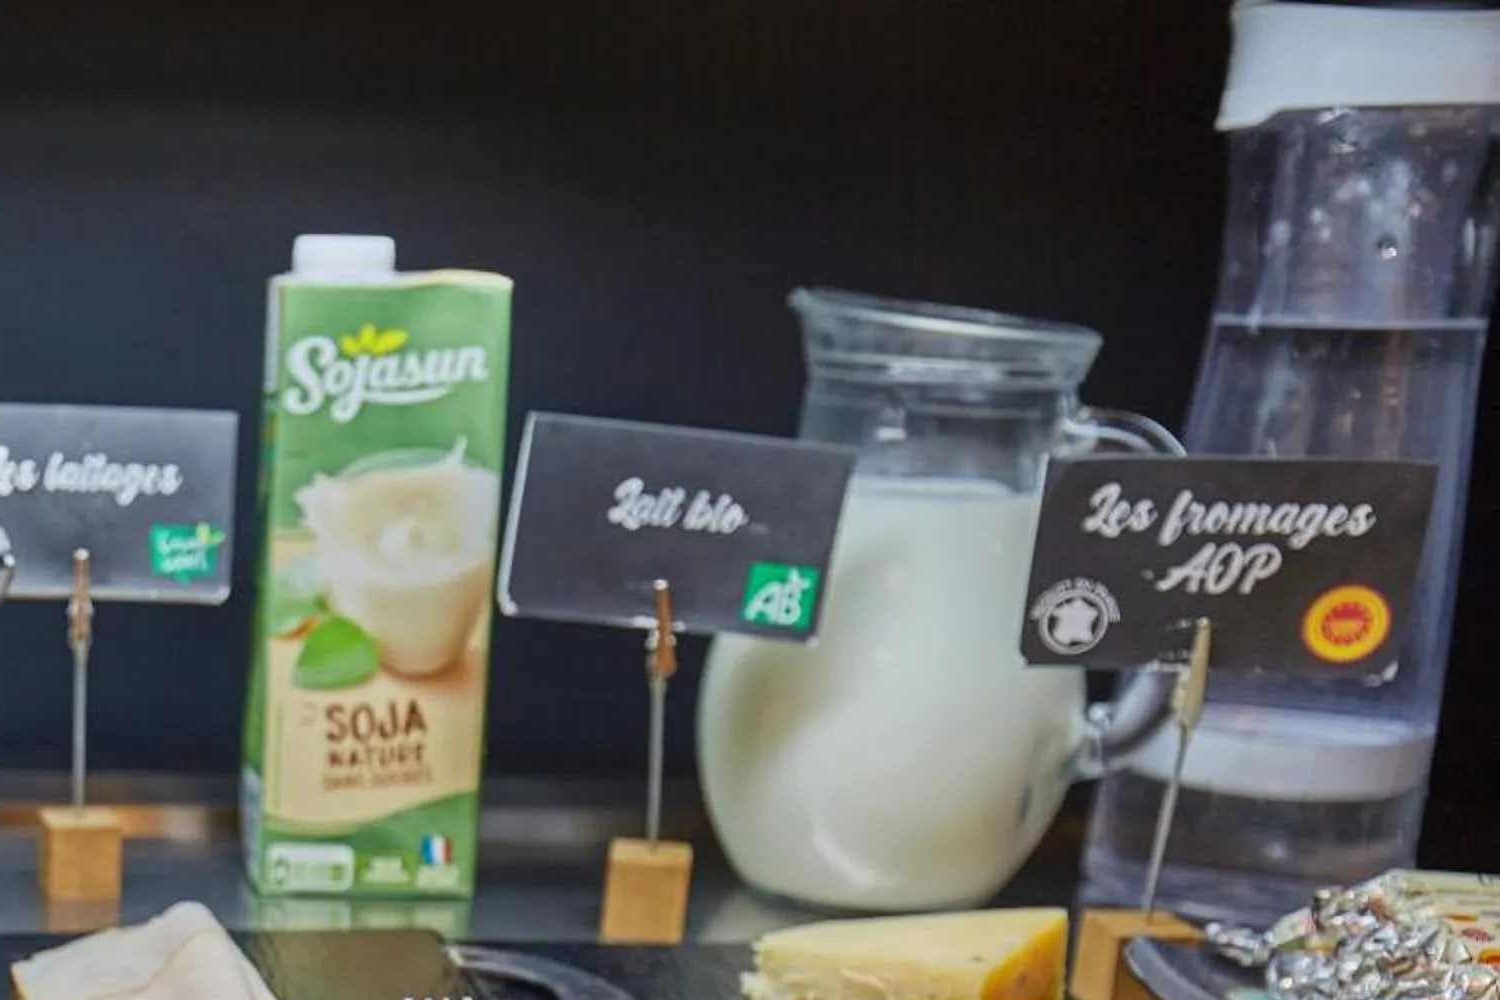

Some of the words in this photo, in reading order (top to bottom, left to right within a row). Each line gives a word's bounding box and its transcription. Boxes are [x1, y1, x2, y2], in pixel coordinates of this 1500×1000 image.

[281, 334, 490, 424] Sojasun
[1081, 481, 1159, 538] Les
[1156, 488, 1377, 550] fromages
[1154, 541, 1283, 595] AOP
[325, 699, 428, 743] SOJA
